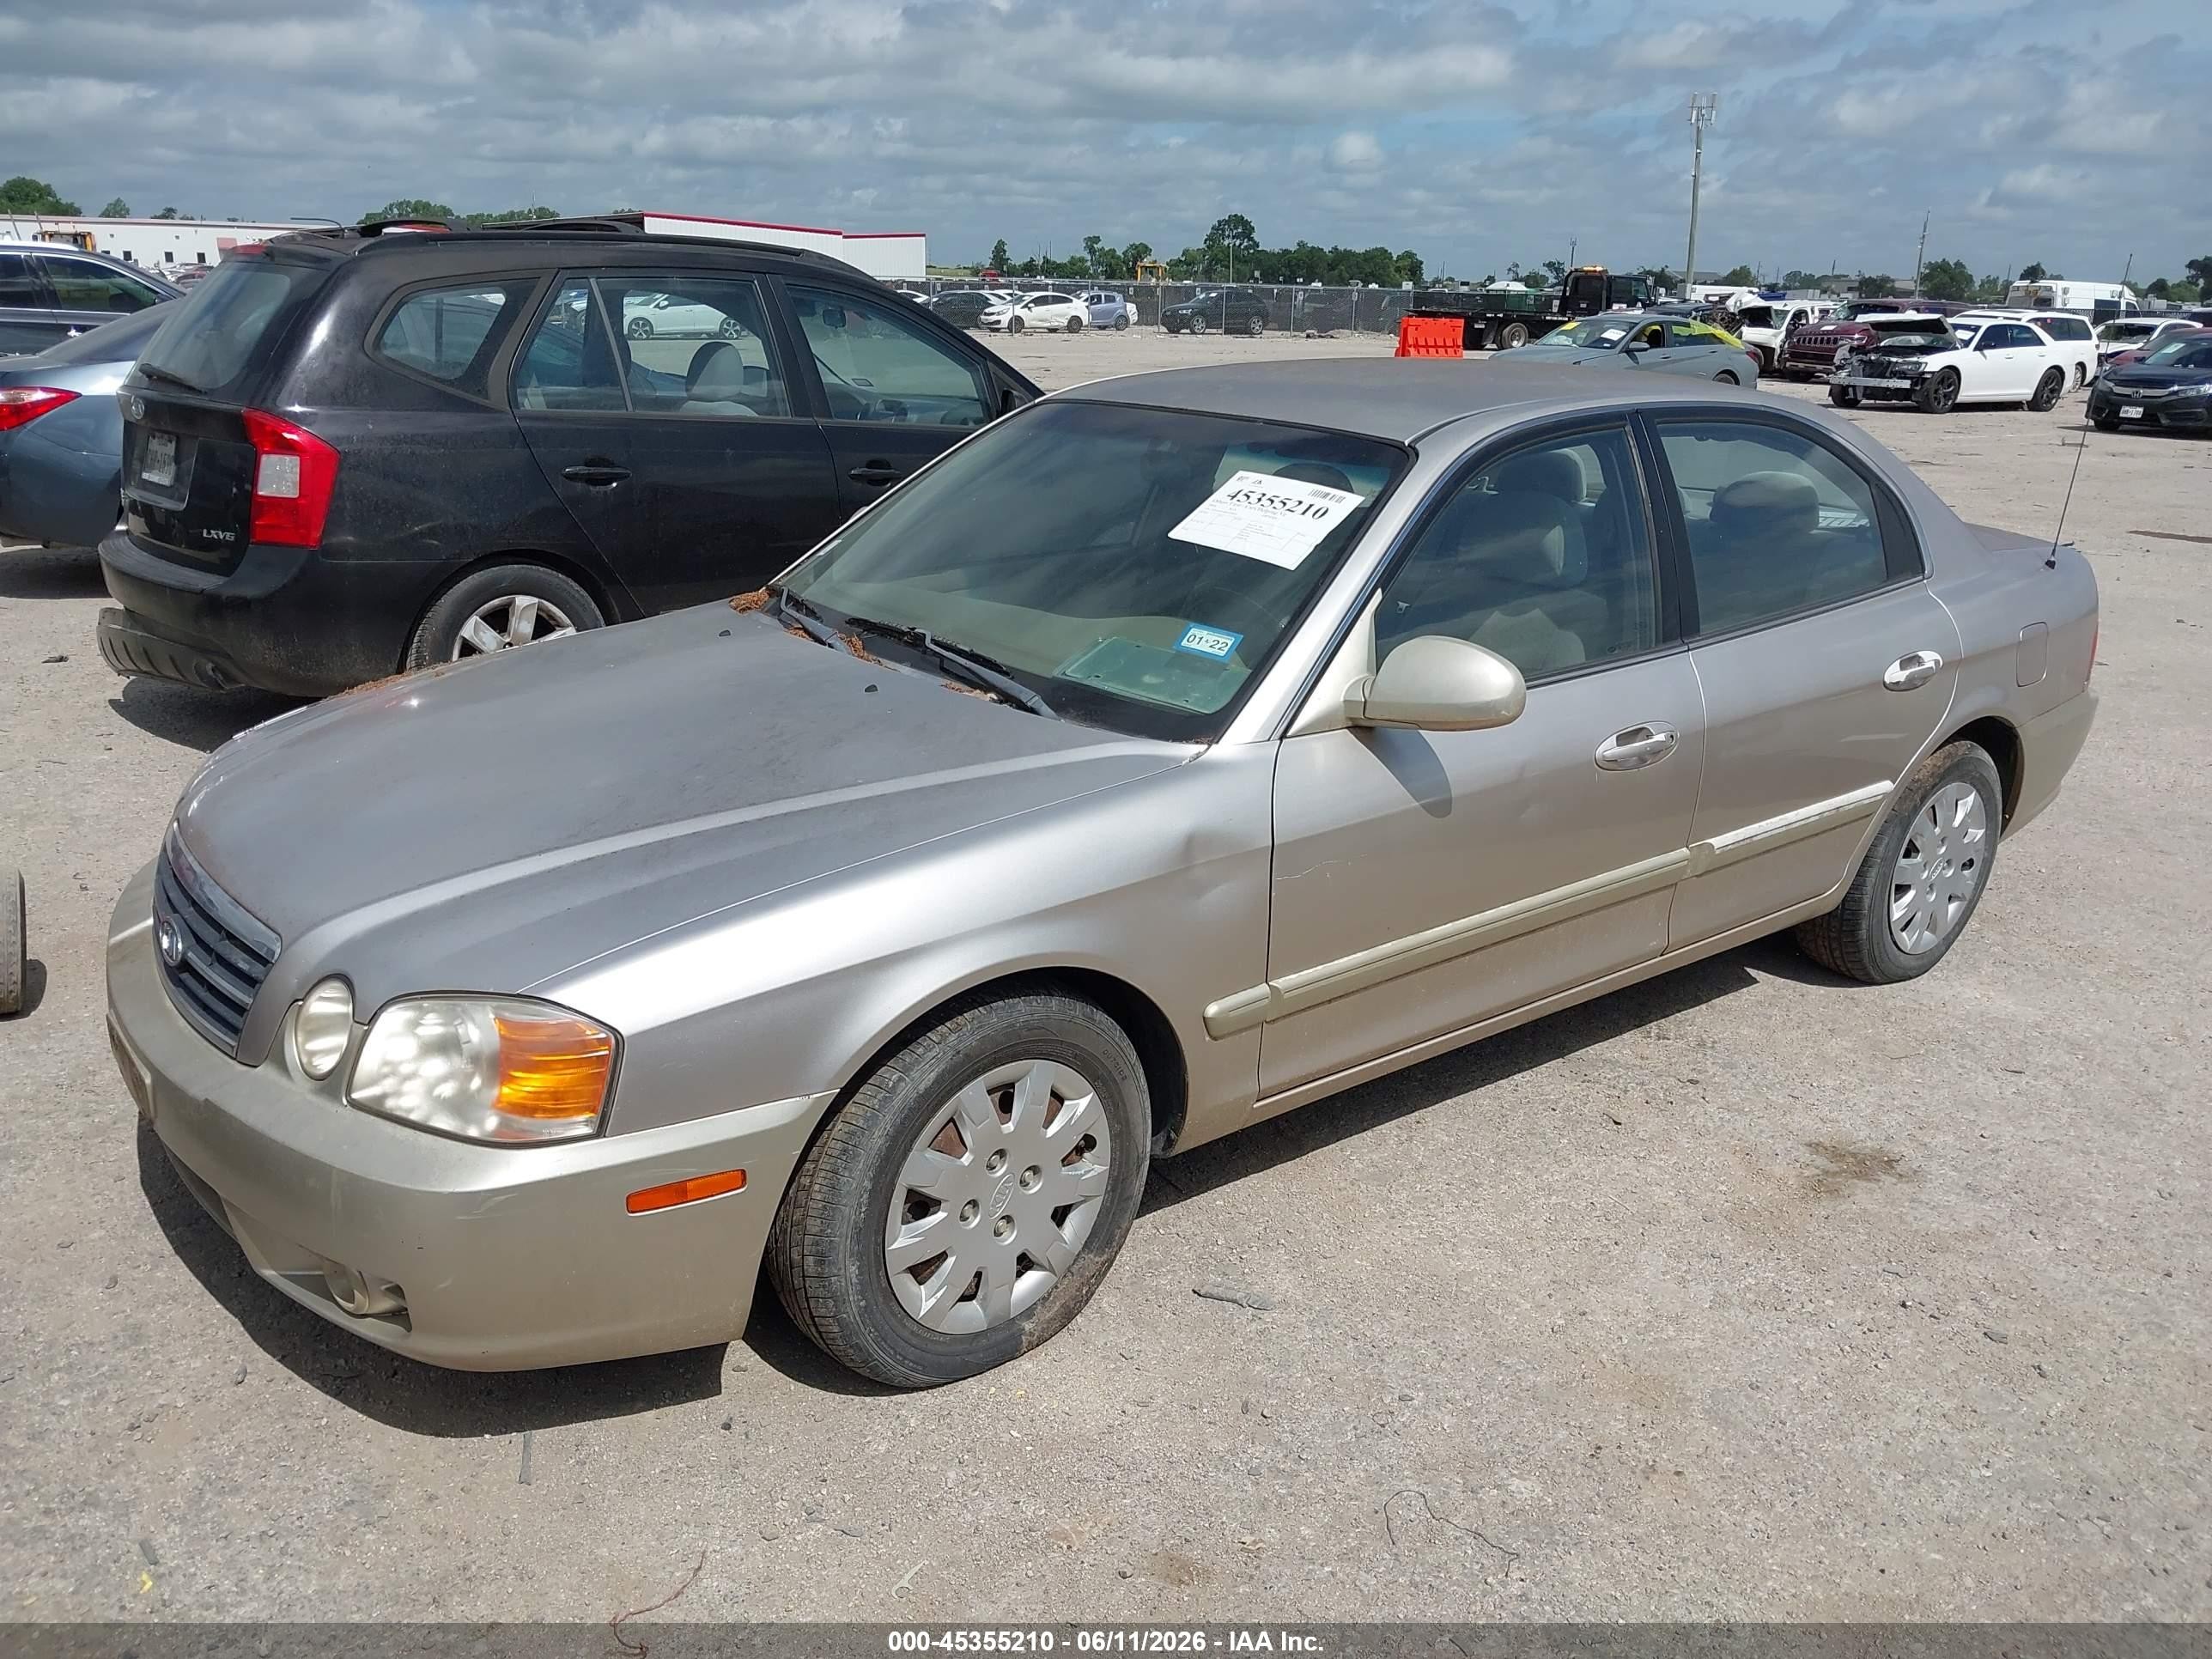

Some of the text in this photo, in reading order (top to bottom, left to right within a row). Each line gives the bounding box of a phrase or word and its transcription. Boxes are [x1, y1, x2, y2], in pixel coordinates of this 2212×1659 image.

[1227, 488, 1330, 520] 45355210
[1187, 634, 1229, 652] 01 22
